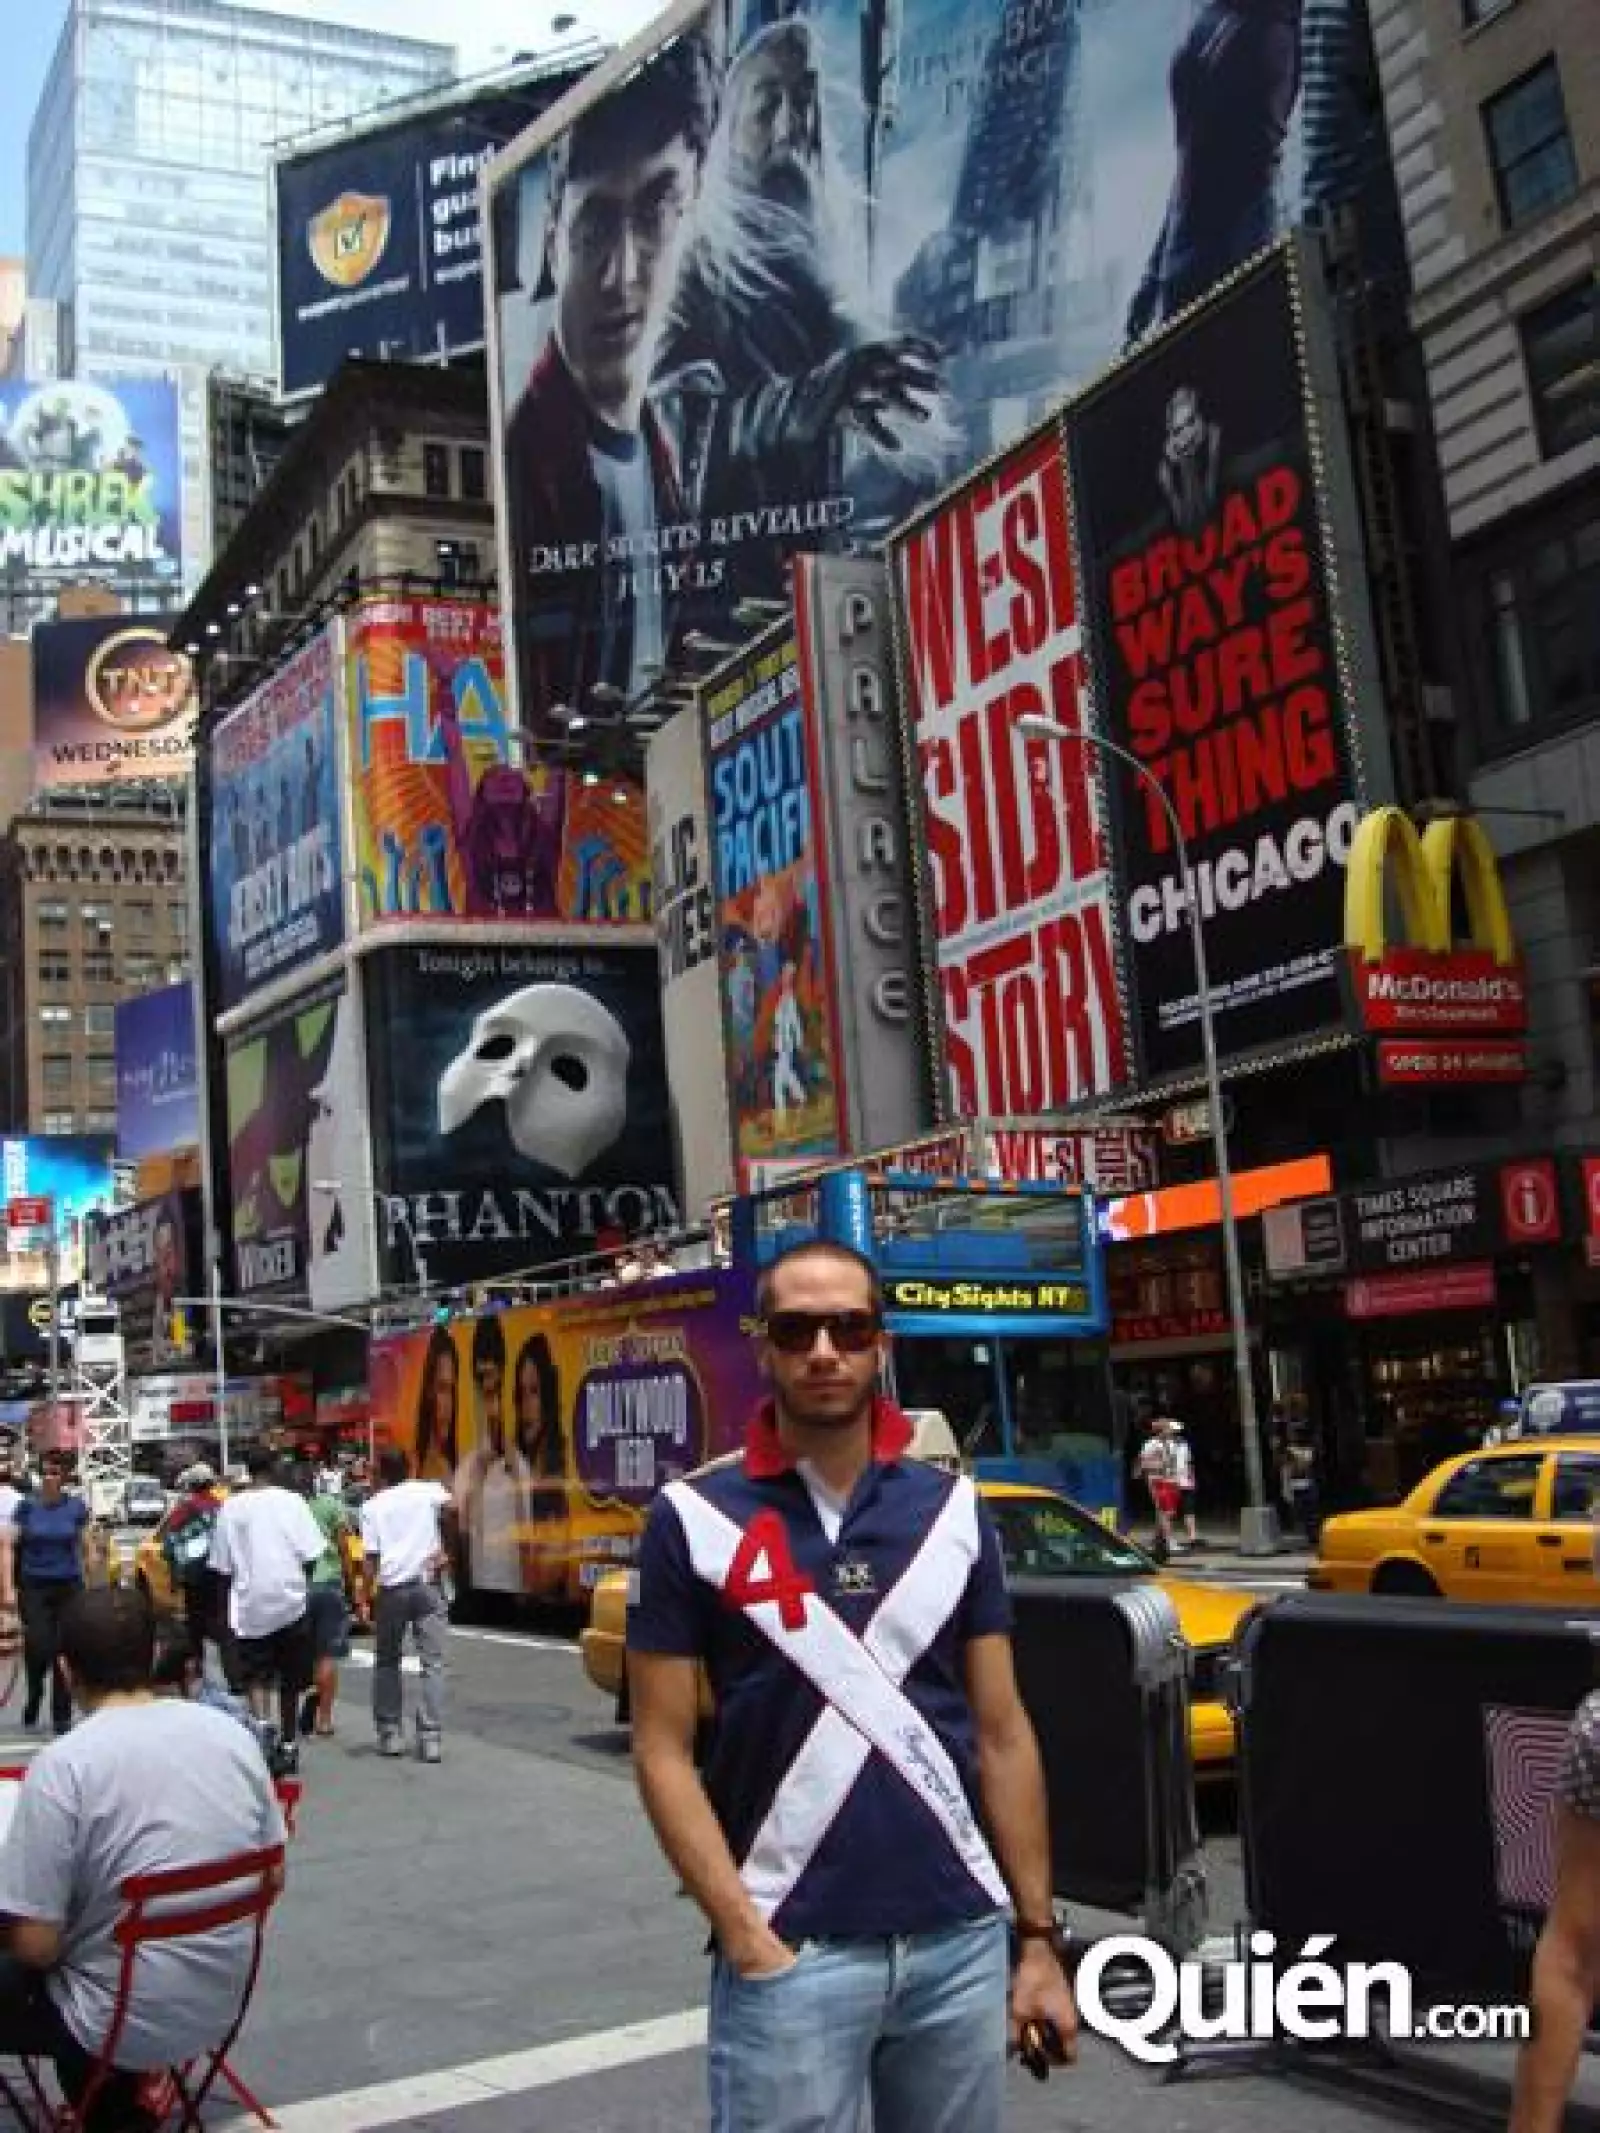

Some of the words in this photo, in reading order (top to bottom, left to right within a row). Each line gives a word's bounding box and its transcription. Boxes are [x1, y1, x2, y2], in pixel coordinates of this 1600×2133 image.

[528, 542, 599, 574] DARK
[695, 556, 728, 589] 15
[905, 450, 1079, 724] WEST
[1112, 463, 1301, 619] BROAD
[1115, 528, 1310, 679] WAY'S
[102, 663, 177, 698] TNT
[1127, 600, 1326, 754] SURE
[840, 590, 910, 1022] PALACE
[917, 650, 1109, 940] SIDE
[1136, 685, 1335, 853] THING
[1129, 802, 1358, 943] CHICAGO
[1367, 974, 1523, 1001] McDonald's
[1355, 1186, 1405, 1217] TIMES
[1408, 1175, 1477, 1209] SQUARE
[1361, 1204, 1477, 1241] INFORMATION
[1387, 1232, 1451, 1263] CENTER
[721, 1505, 816, 1632] 4
